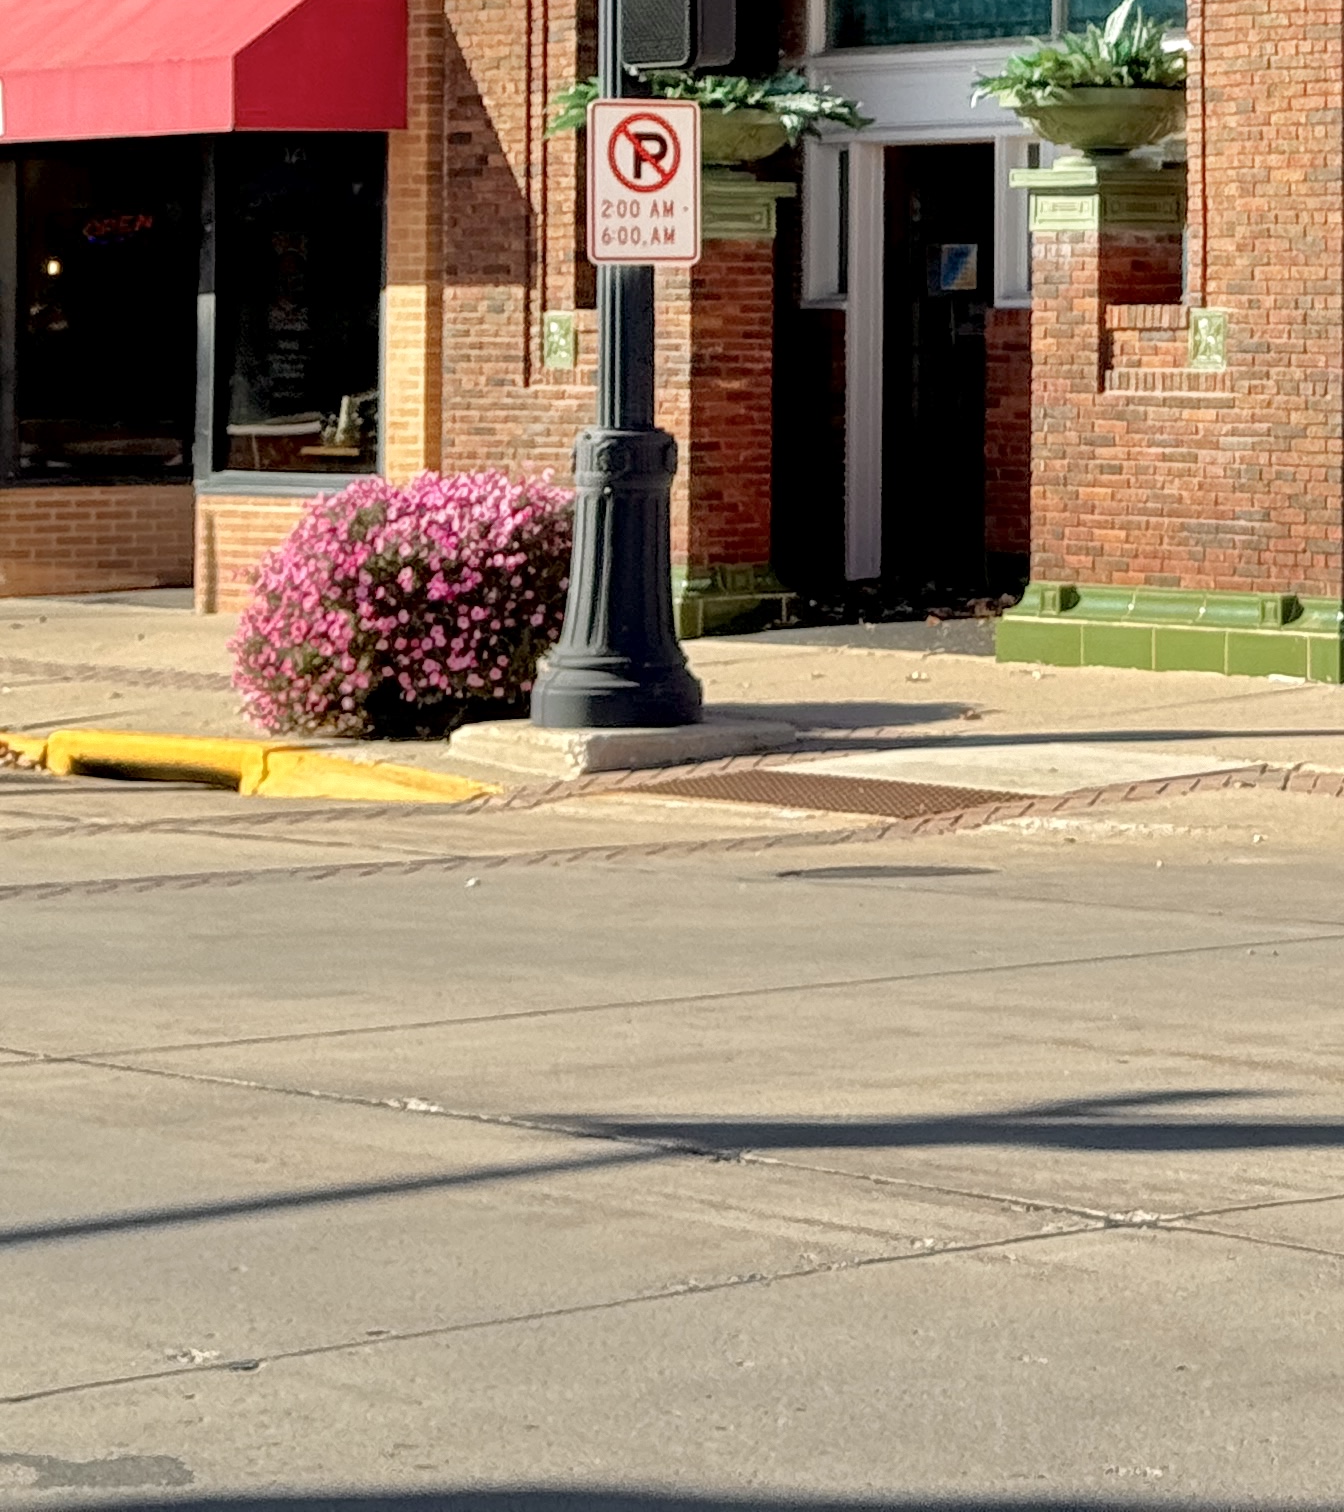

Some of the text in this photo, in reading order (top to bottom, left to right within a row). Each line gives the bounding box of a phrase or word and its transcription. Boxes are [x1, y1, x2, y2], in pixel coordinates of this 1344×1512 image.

[650, 199, 674, 218] AM
[82, 214, 154, 237] OPEN
[651, 226, 676, 245] AM
